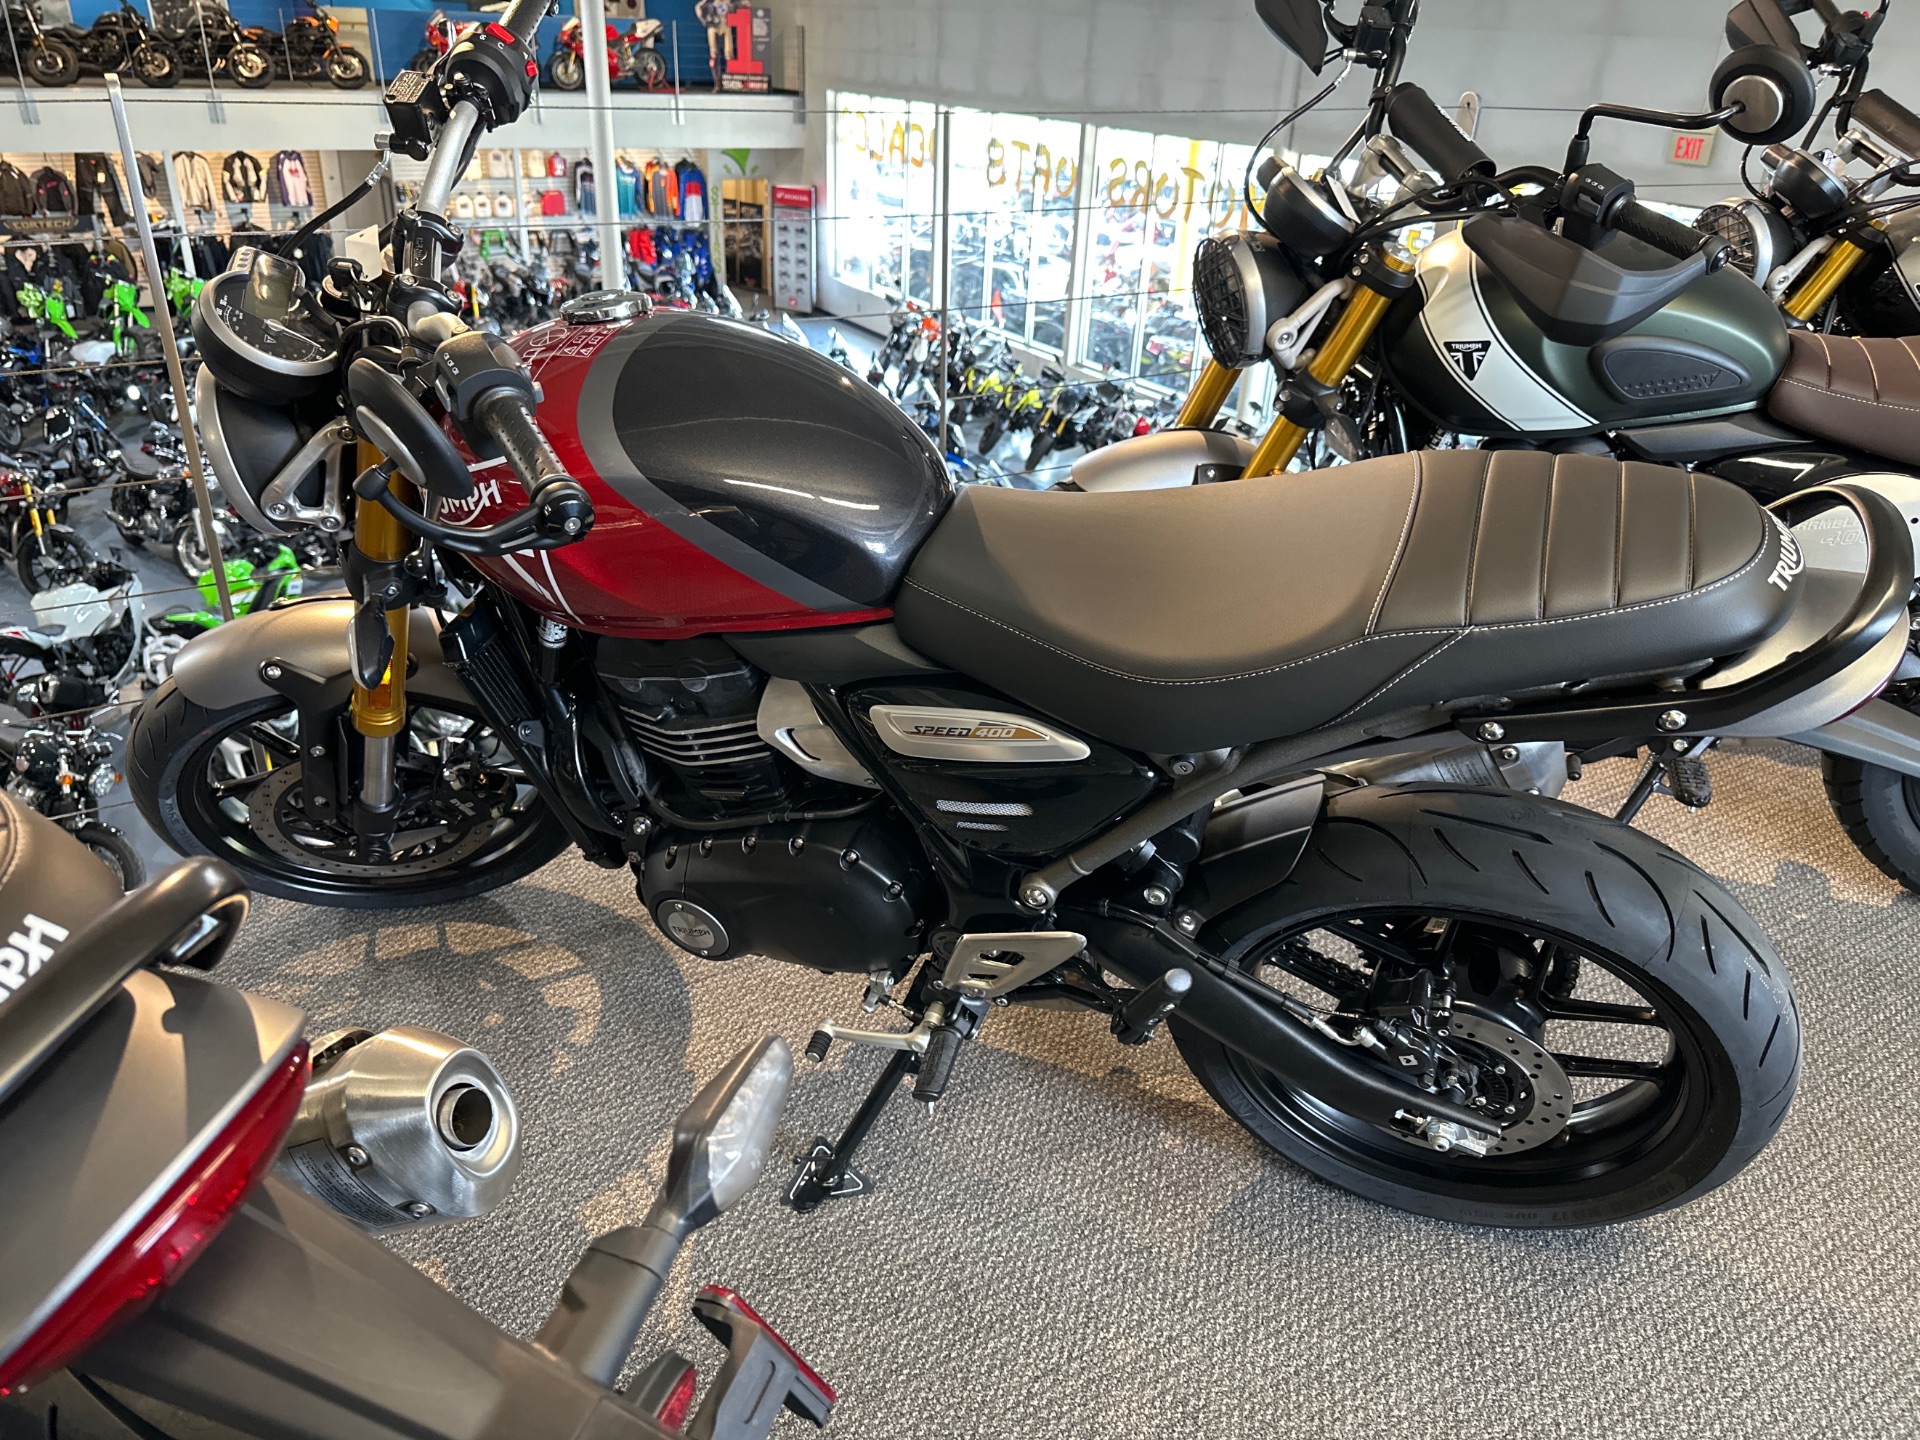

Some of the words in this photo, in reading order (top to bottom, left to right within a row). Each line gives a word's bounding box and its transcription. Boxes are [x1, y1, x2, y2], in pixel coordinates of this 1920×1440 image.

[1674, 136, 1705, 160] EXIT
[911, 725, 972, 737] SPEED
[976, 728, 1016, 738] 400
[672, 926, 711, 936] TRIUMPH
